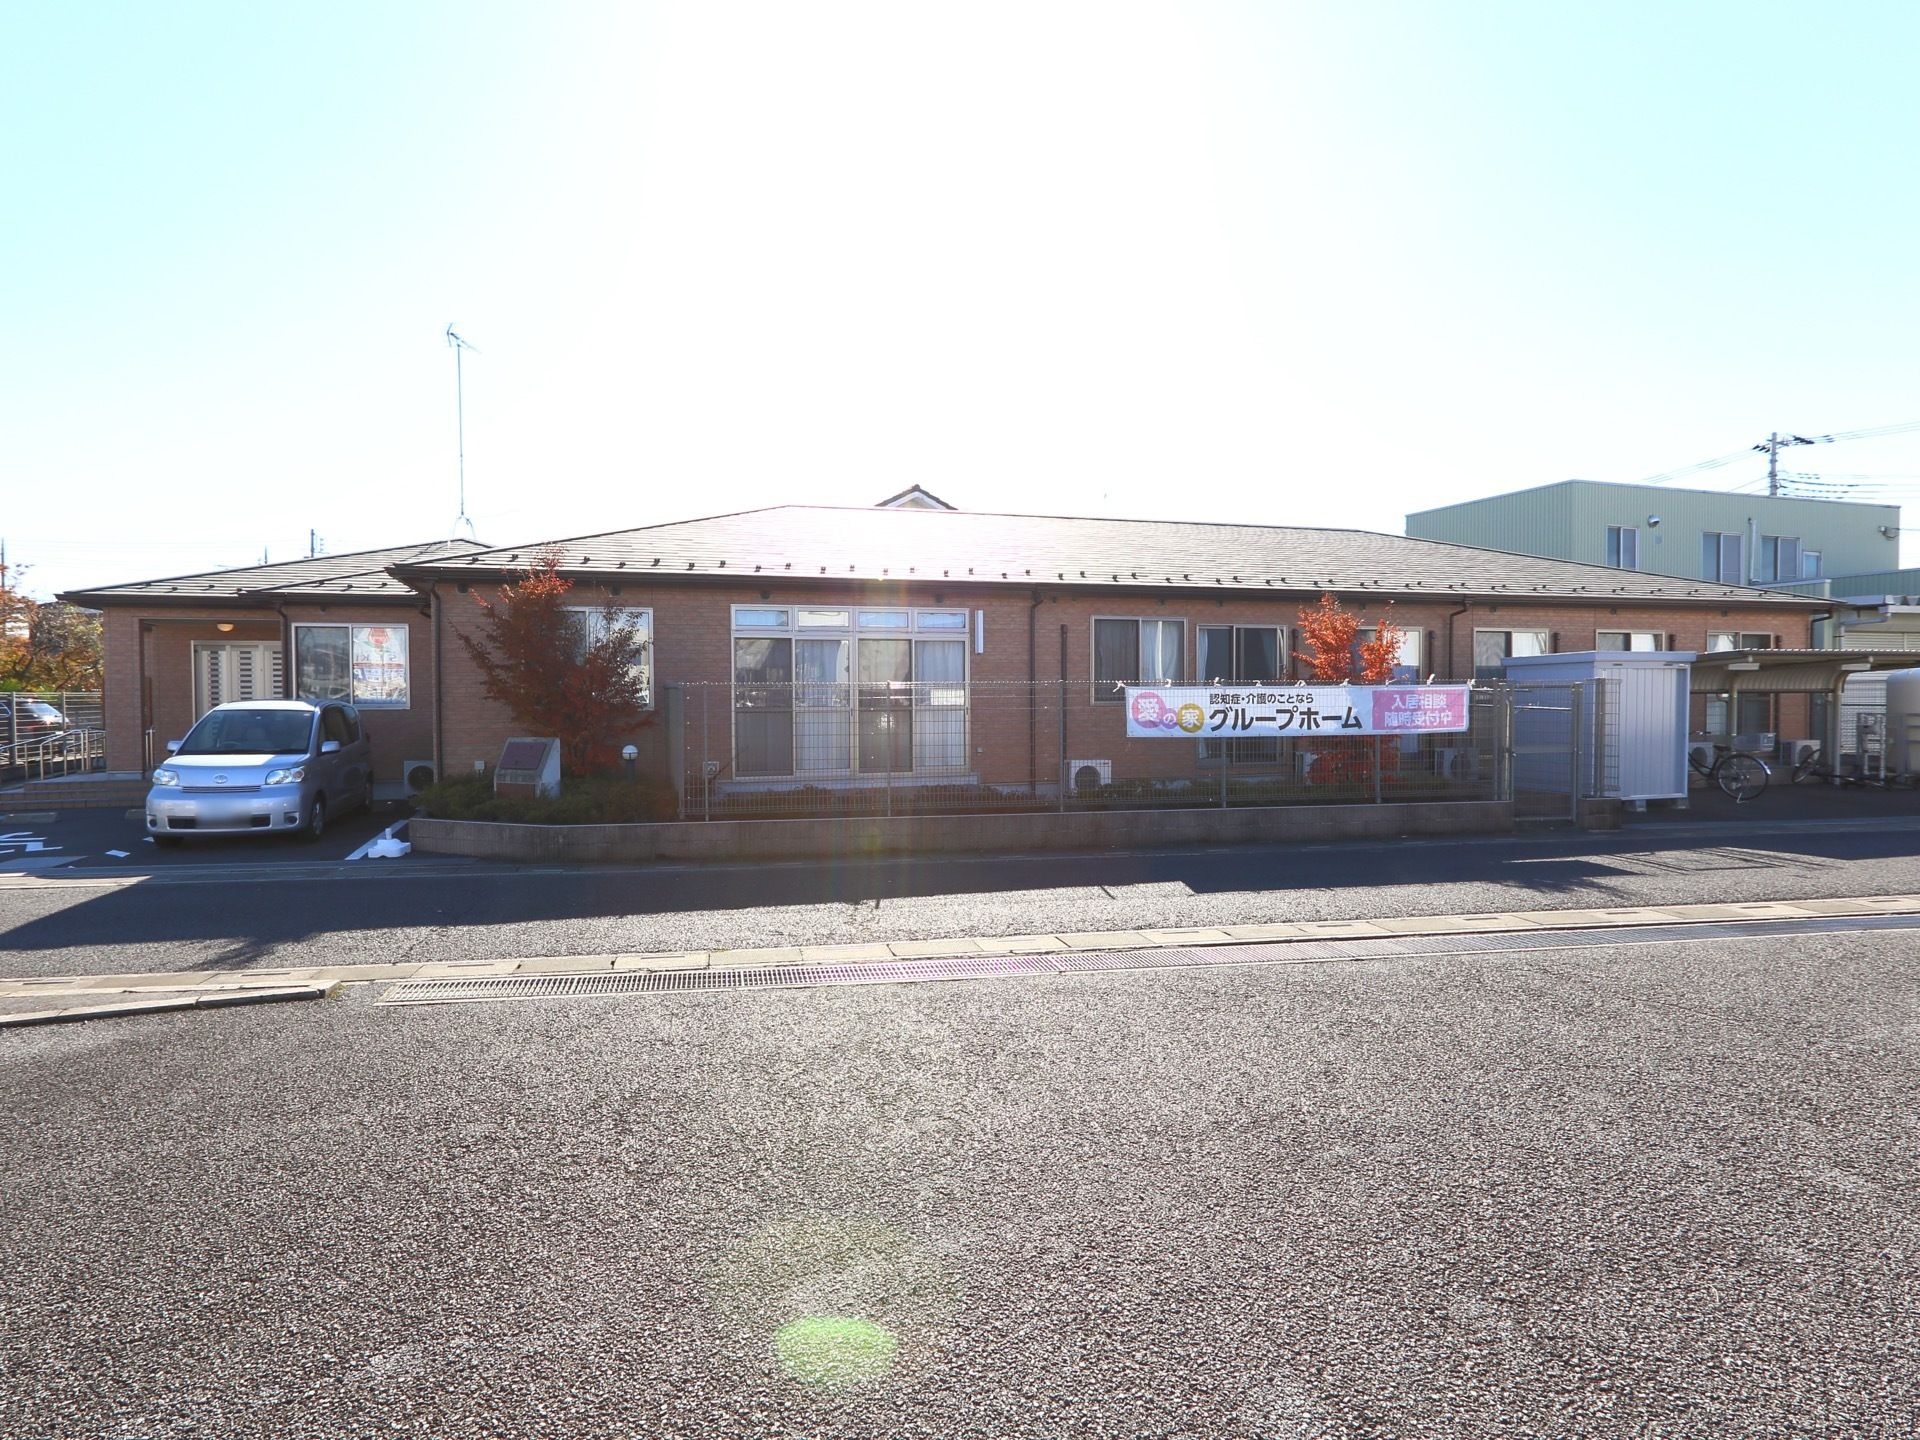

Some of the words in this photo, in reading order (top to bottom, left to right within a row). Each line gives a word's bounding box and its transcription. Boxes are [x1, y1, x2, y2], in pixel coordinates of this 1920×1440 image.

[1209, 693, 1314, 705] 認知症・介護のことなら
[1391, 694, 1447, 710] 入居相談
[1209, 705, 1363, 732] グループホーム
[1384, 710, 1452, 727] 随時受付中
